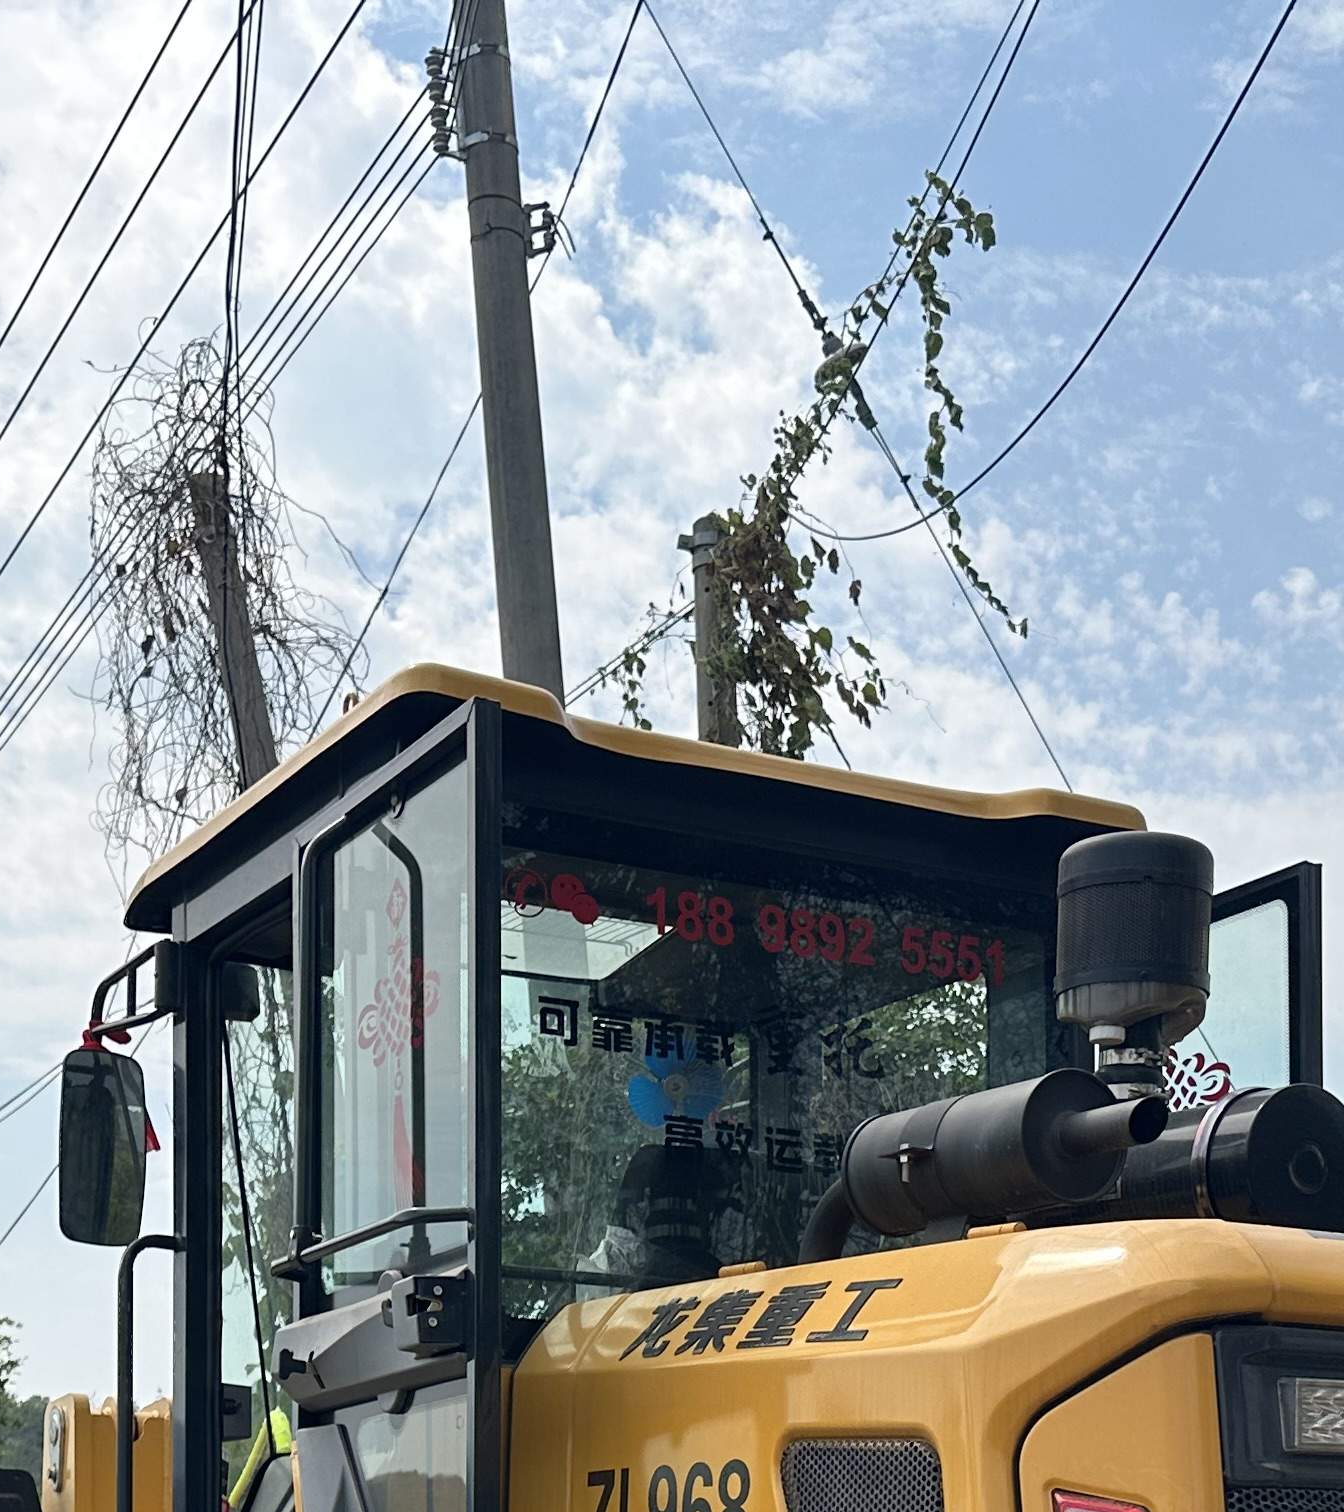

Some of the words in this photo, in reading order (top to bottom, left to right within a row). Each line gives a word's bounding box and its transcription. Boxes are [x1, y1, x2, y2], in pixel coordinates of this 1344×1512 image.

[645, 886, 735, 946] 188
[758, 904, 877, 967] 9892
[900, 927, 1006, 986] 5551
